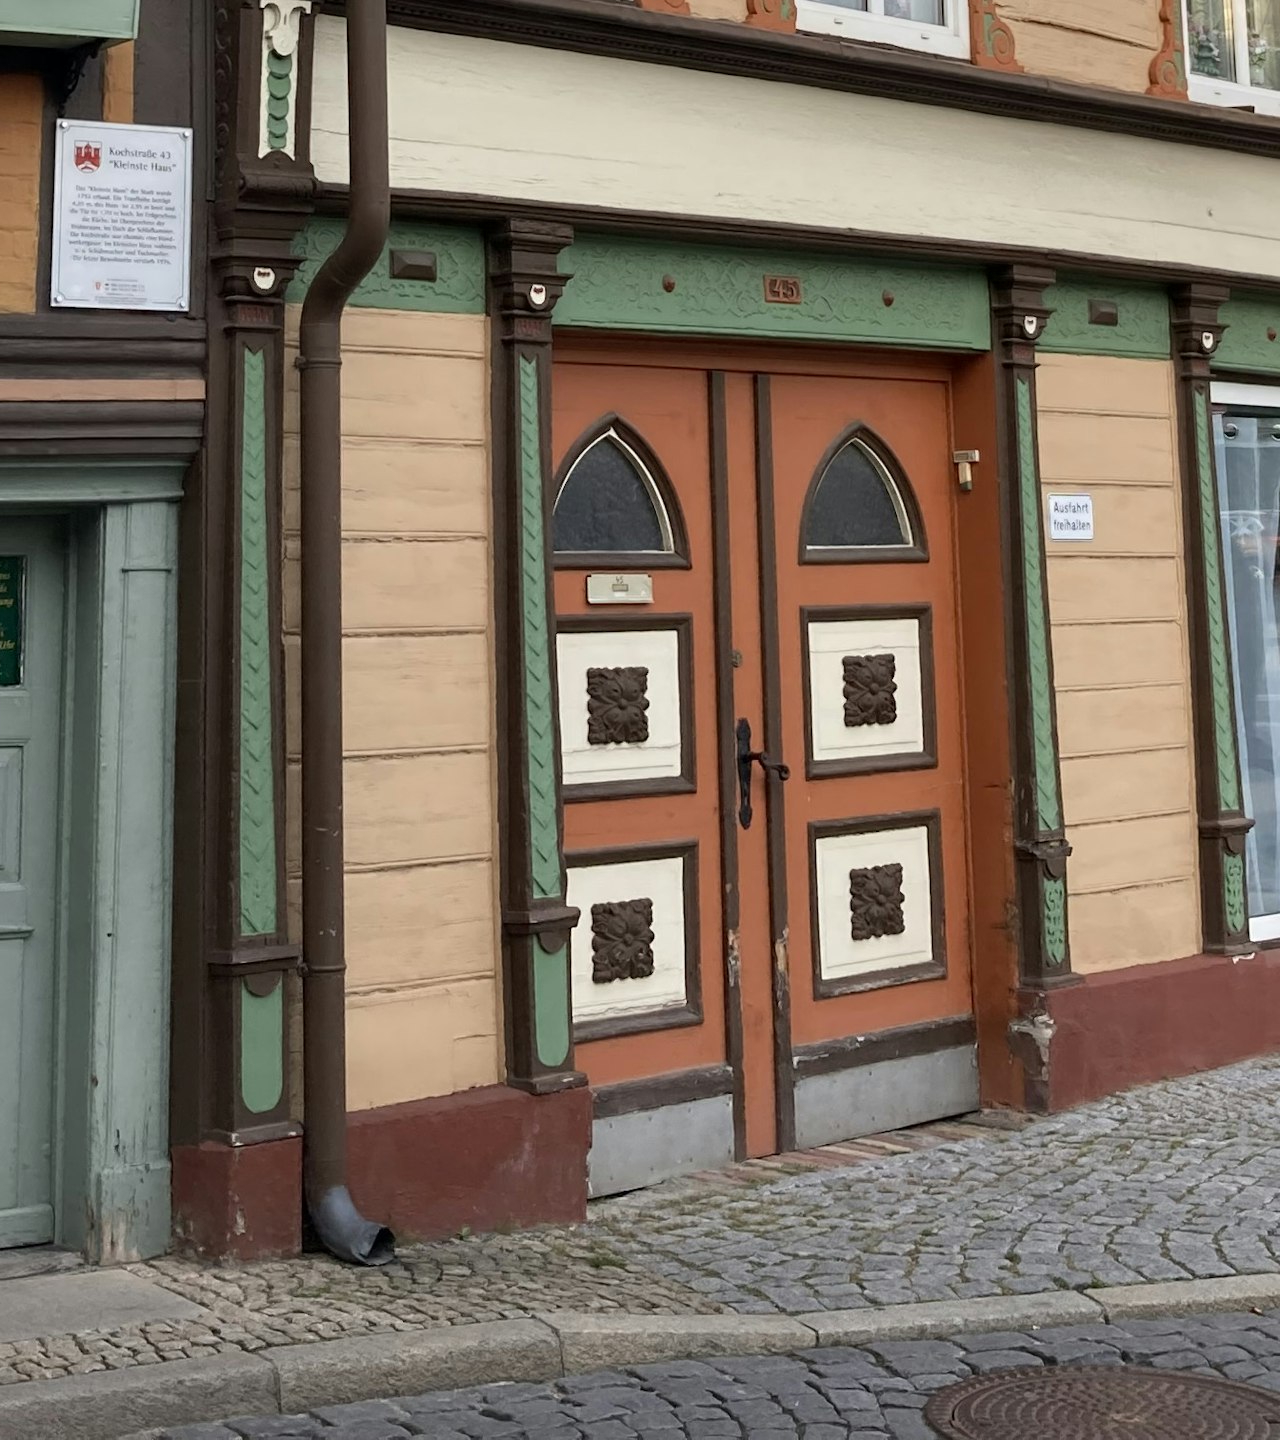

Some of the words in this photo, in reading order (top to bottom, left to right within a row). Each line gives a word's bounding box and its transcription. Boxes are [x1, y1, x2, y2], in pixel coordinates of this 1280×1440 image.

[109, 147, 158, 160] Kochstraße
[160, 150, 171, 160] 43
[772, 278, 799, 301] 45
[1054, 502, 1088, 514] Ausfahrt
[1054, 519, 1091, 531] freihalten
